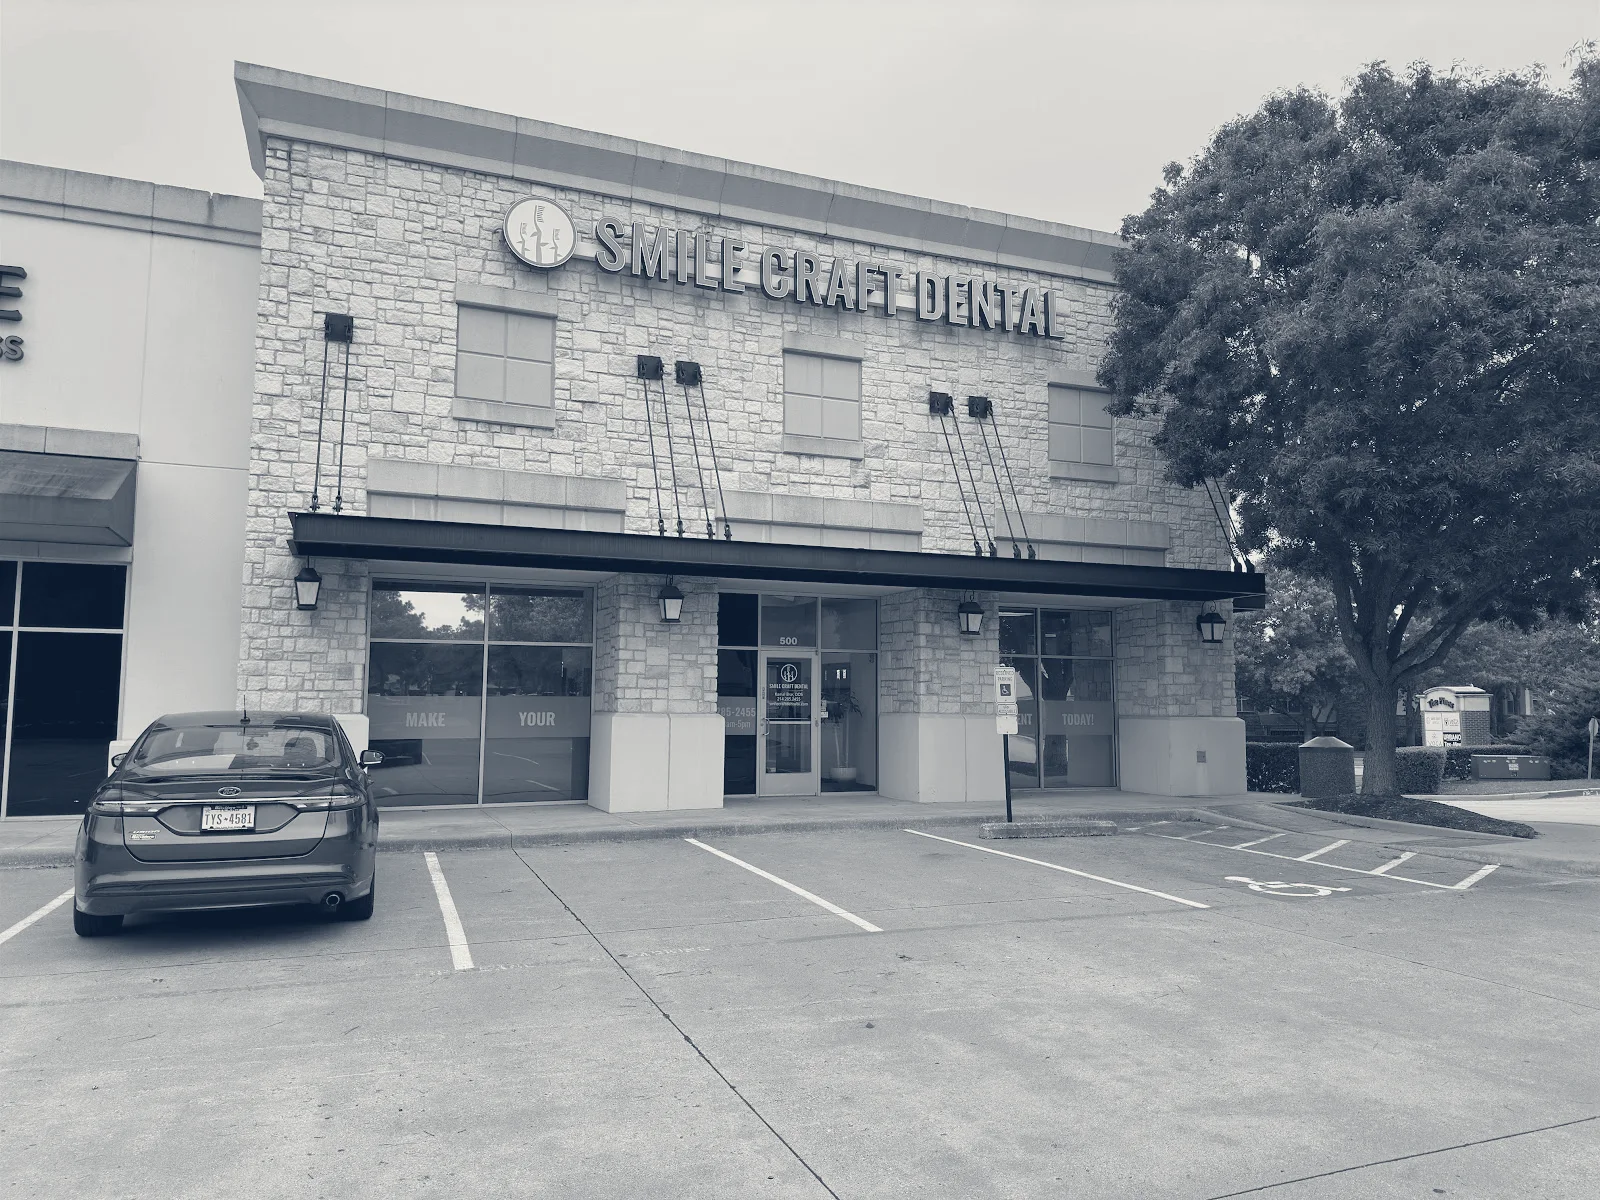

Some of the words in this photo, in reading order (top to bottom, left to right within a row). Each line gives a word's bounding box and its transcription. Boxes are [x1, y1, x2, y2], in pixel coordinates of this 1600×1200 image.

[595, 215, 746, 295] SMILE
[760, 246, 903, 317] CRAFT
[916, 270, 1067, 340] DENTAL
[780, 637, 798, 645] 500
[406, 712, 446, 727] MAKE
[519, 711, 555, 726] YOUR
[1062, 713, 1095, 726] TODAY!
